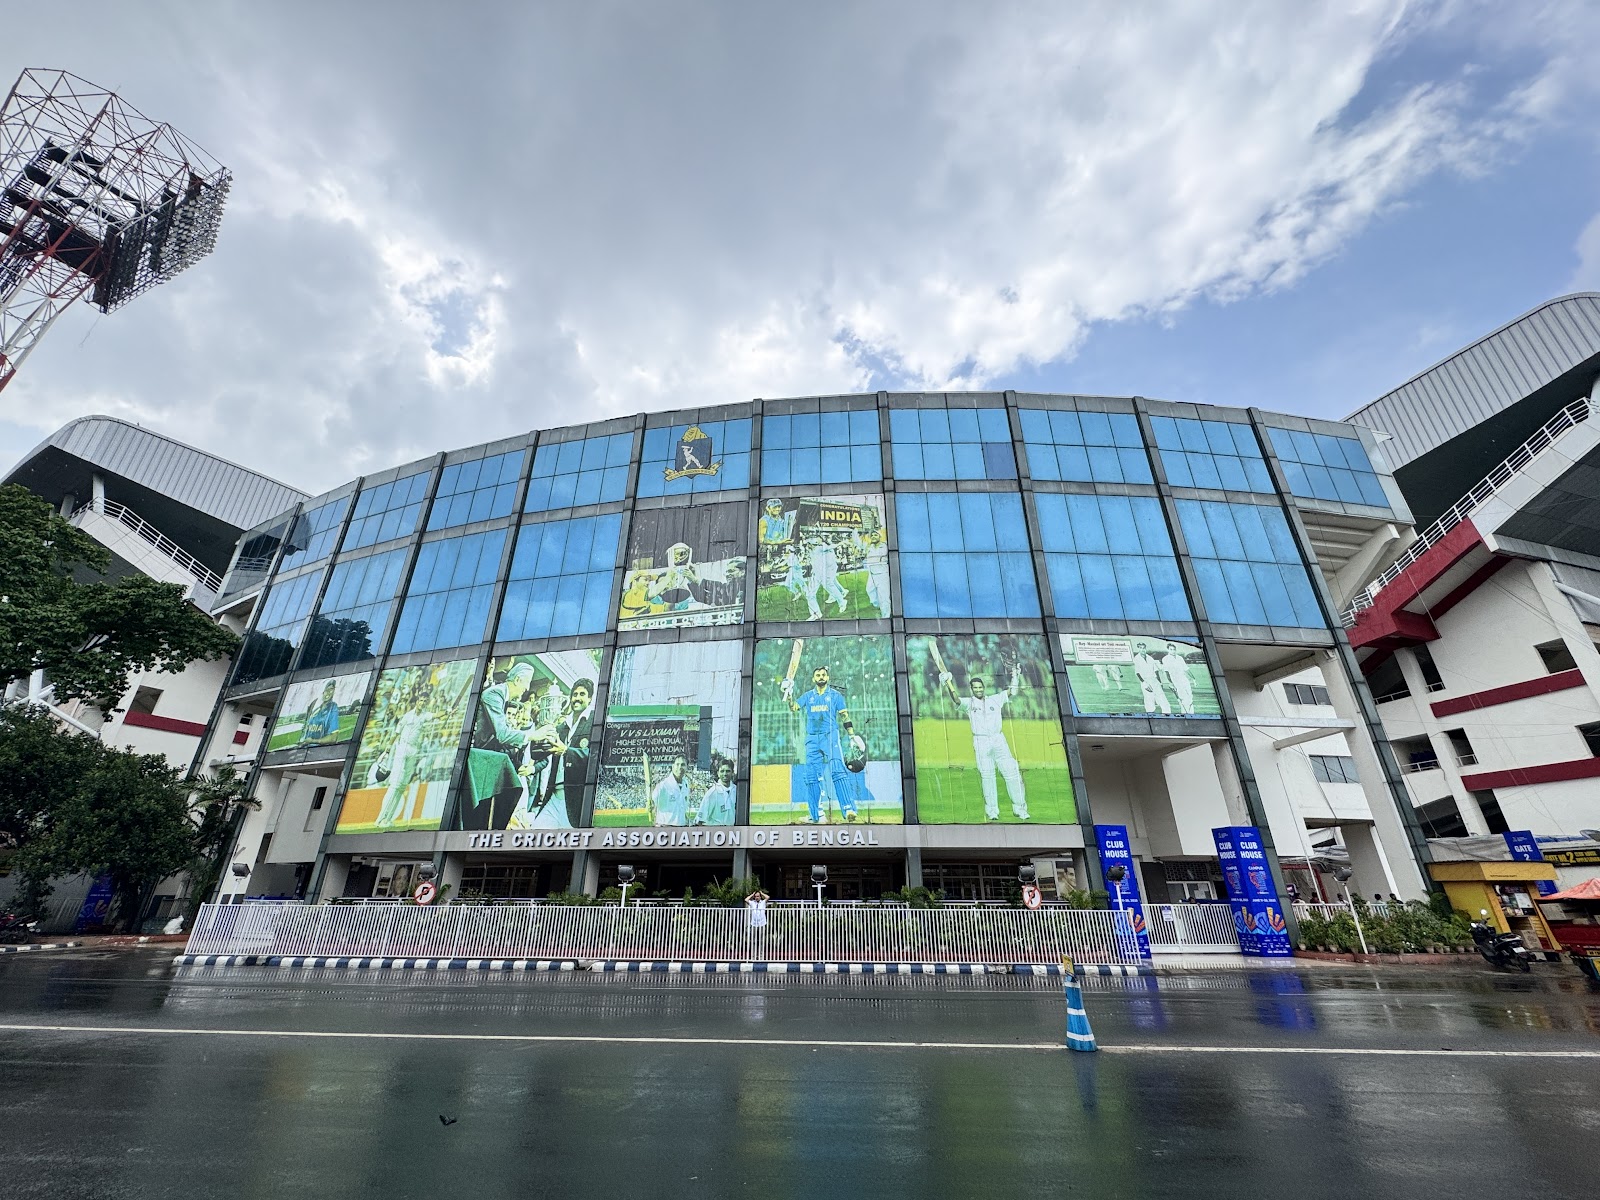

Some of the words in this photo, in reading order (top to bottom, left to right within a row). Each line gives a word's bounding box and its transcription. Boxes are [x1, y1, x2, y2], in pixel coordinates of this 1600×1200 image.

[820, 510, 861, 522] INDIA
[468, 833, 502, 847] THE
[512, 832, 594, 847] CRICKET
[602, 829, 742, 846] ASSOCIATION
[753, 829, 780, 845] OF
[791, 829, 879, 846] BENGAL
[1566, 852, 1576, 863] 2
